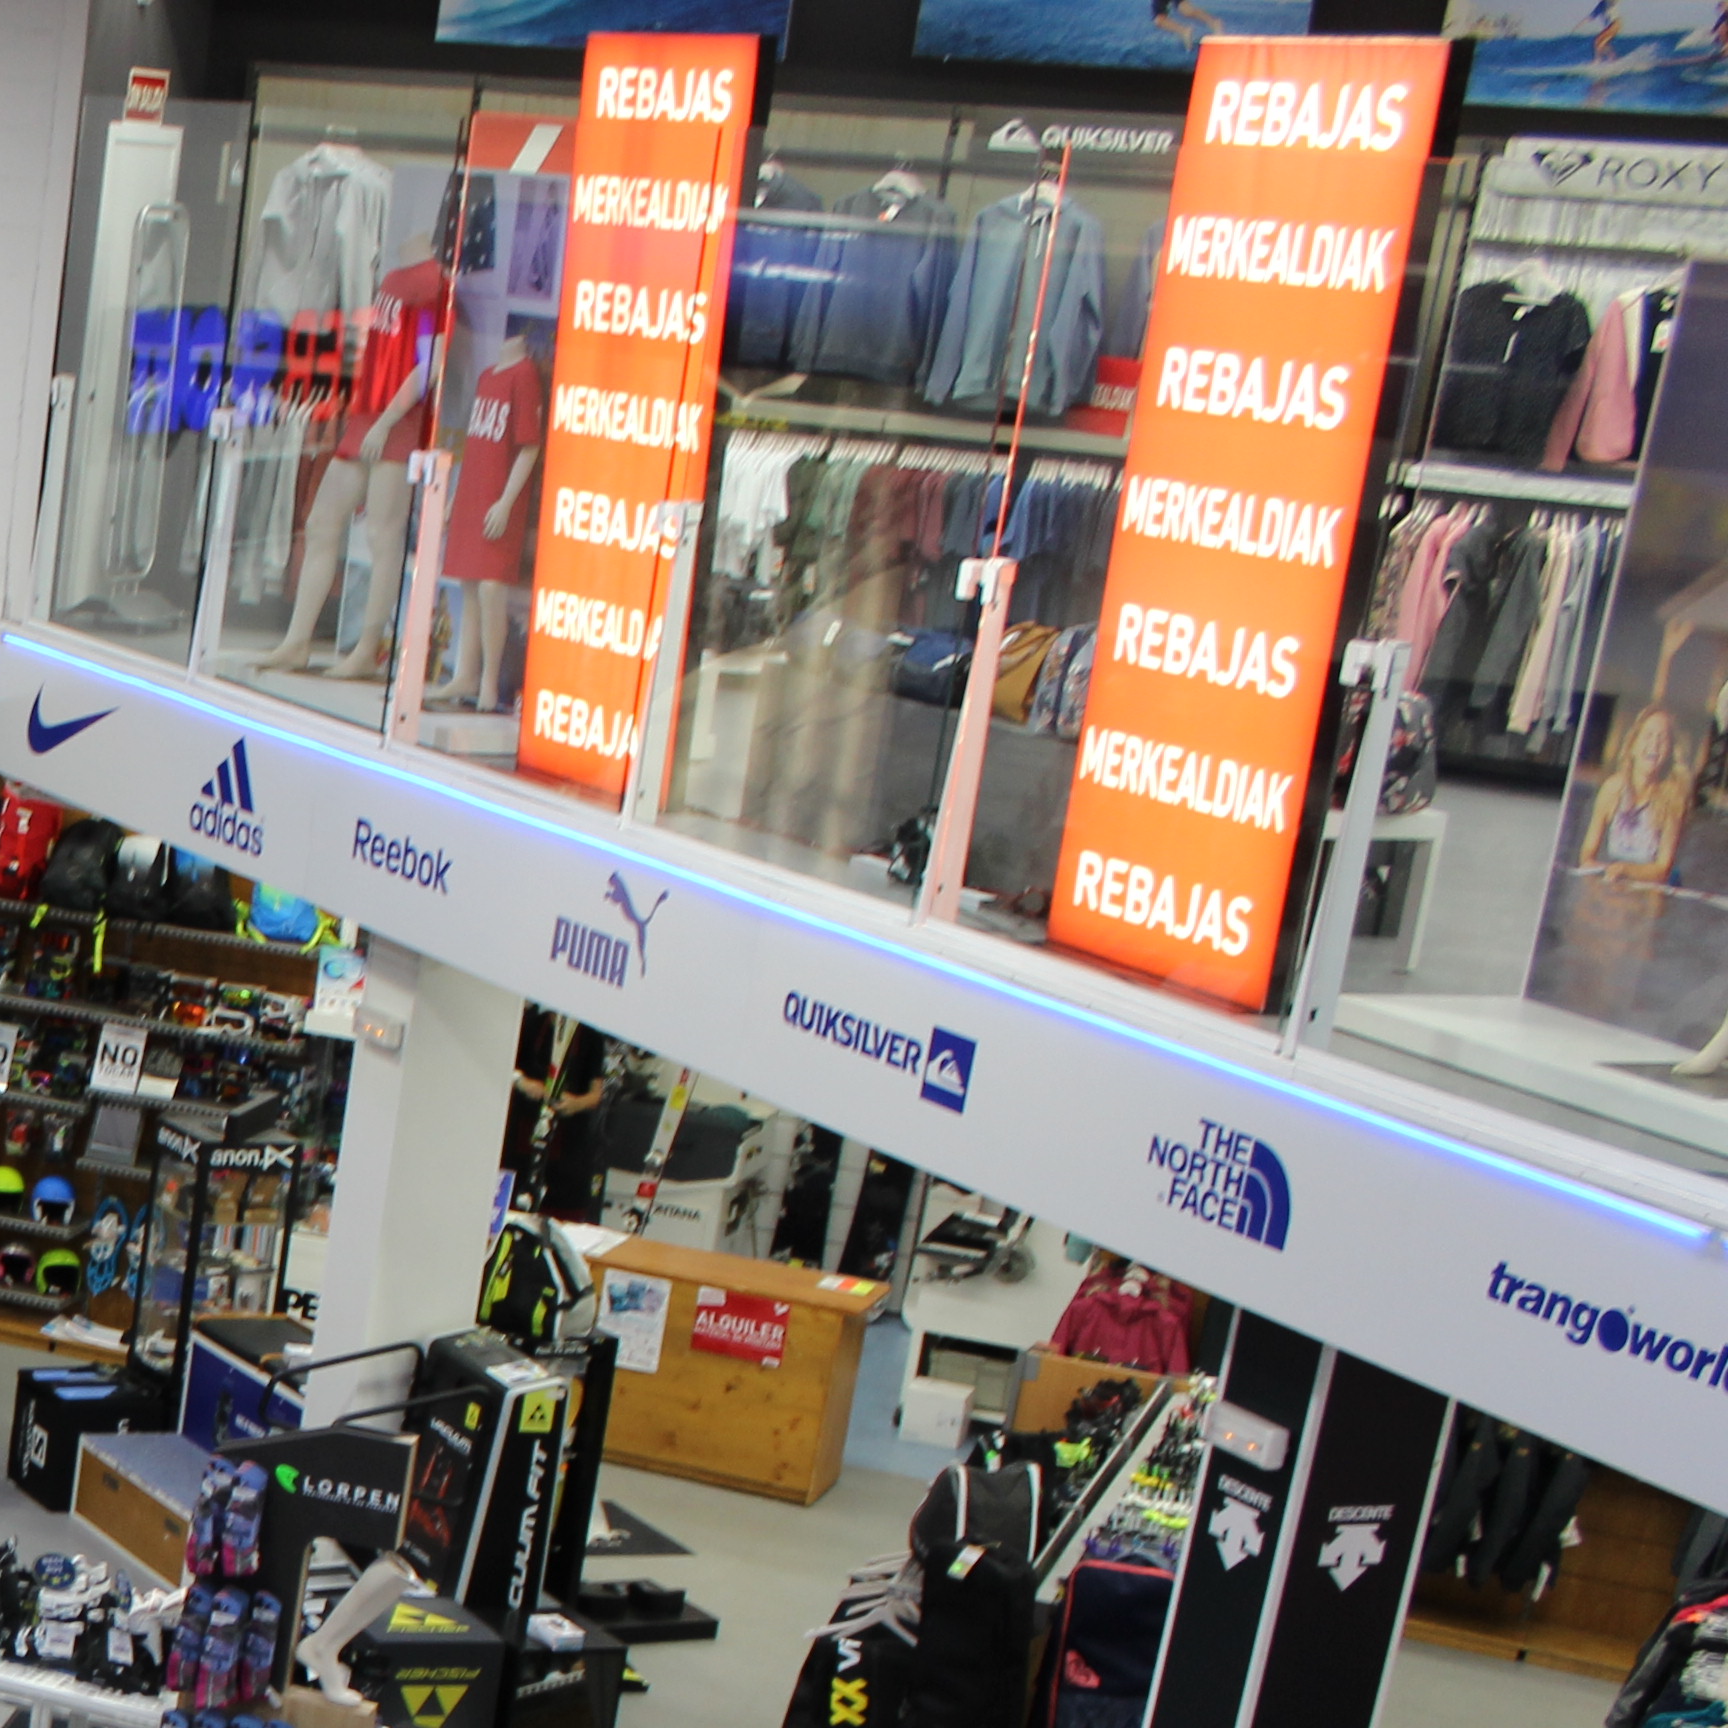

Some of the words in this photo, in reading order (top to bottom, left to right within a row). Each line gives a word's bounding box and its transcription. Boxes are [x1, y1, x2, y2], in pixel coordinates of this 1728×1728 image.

[597, 67, 734, 123] REBAJAS
[1204, 80, 1409, 152] REBAJAS
[1041, 124, 1175, 154] QUIKSILVER
[572, 174, 729, 234] MERKEALDIAK
[1596, 156, 1726, 192] ROXY
[1165, 215, 1398, 294] MERKEALDIAK
[574, 280, 707, 345] REBAJAS
[554, 383, 703, 454] MERKEALDIAK
[1156, 346, 1349, 431] REBAJAS
[554, 487, 680, 560] REBAJAS
[1122, 474, 1342, 569] MERKEALDIAK
[1113, 603, 1301, 699] REBAJAS
[534, 689, 638, 760] REBAJA
[1079, 725, 1293, 834] MERKEALDIAK
[190, 798, 262, 858] adidas
[353, 818, 452, 894] Reebok
[1073, 850, 1253, 957] REBAJAS
[551, 915, 629, 988] PUMA
[100, 1041, 138, 1067] NO
[782, 990, 922, 1078] QUIKSILVER
[1148, 1134, 1246, 1196] NORTH
[1198, 1117, 1255, 1164] THE
[1166, 1180, 1242, 1233] FACE
[697, 1310, 785, 1342] ALQUILER
[1488, 1261, 1728, 1394] trangoworl
[302, 1475, 401, 1508] LORPEN
[1218, 1474, 1273, 1513] DESCENTE
[1328, 1503, 1394, 1523] DESCENTE
